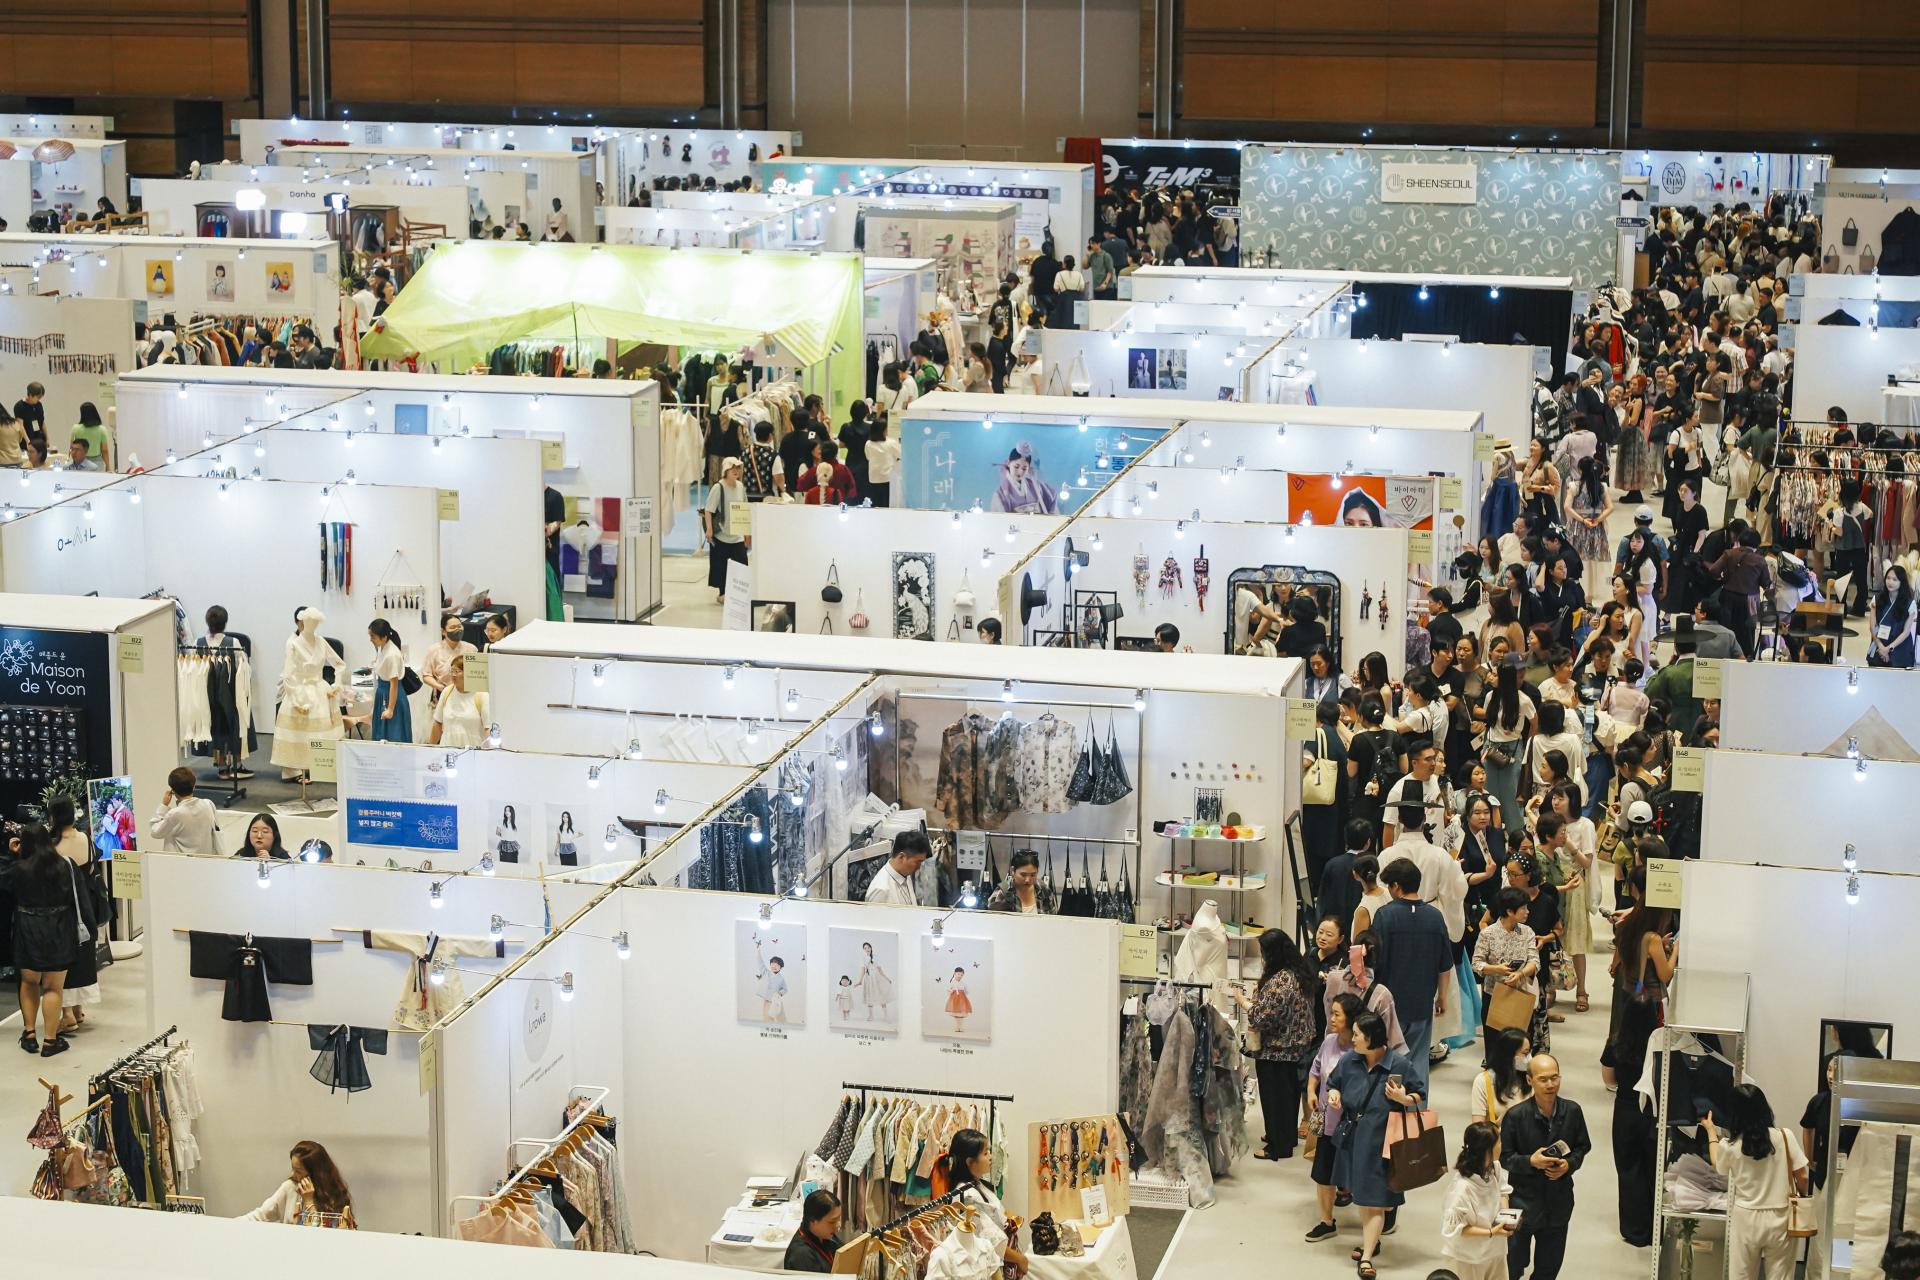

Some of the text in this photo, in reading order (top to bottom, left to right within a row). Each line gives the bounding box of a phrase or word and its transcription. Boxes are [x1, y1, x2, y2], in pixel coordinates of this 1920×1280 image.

[289, 190, 316, 198] Danha
[30, 661, 85, 679] Maison
[20, 677, 86, 697] de Yoon
[1139, 929, 1154, 937] B37
